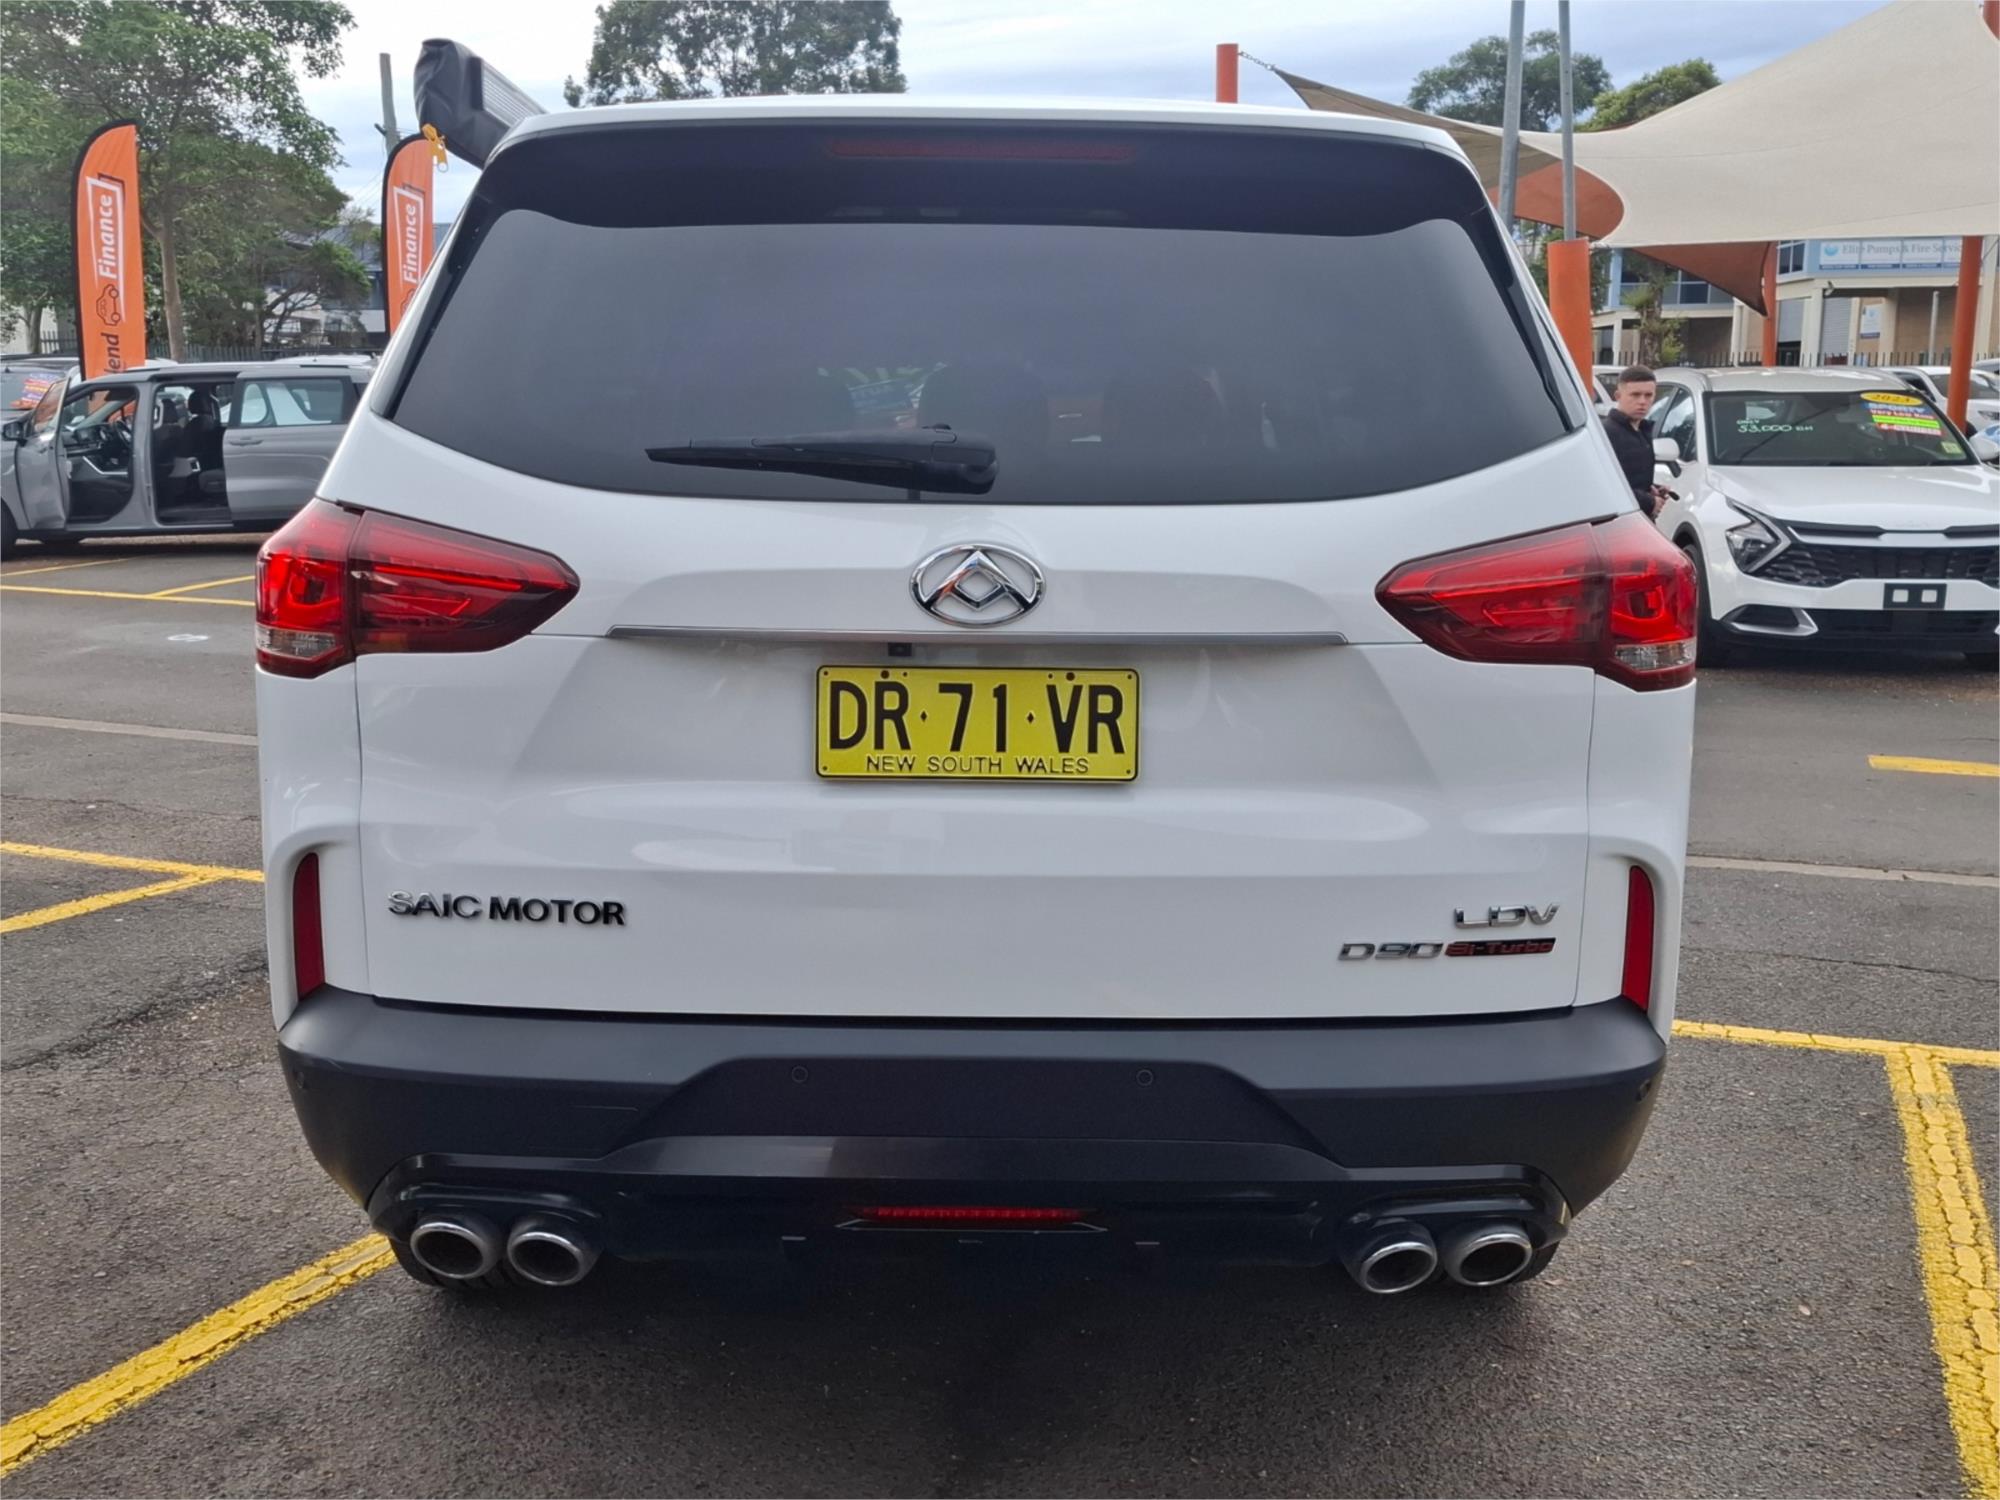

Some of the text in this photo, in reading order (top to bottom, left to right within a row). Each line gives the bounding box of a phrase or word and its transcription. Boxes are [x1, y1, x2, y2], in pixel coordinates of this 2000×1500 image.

[98, 194, 118, 280] Finance
[403, 203, 417, 284] Finance
[829, 680, 1125, 754] DR 71 VR
[867, 755, 1089, 774] NEW SOUTH WALES
[388, 890, 626, 926] SAIC MOTOR
[1454, 903, 1560, 929] LDV
[1338, 939, 1555, 961] D90 Bi-Turbo
